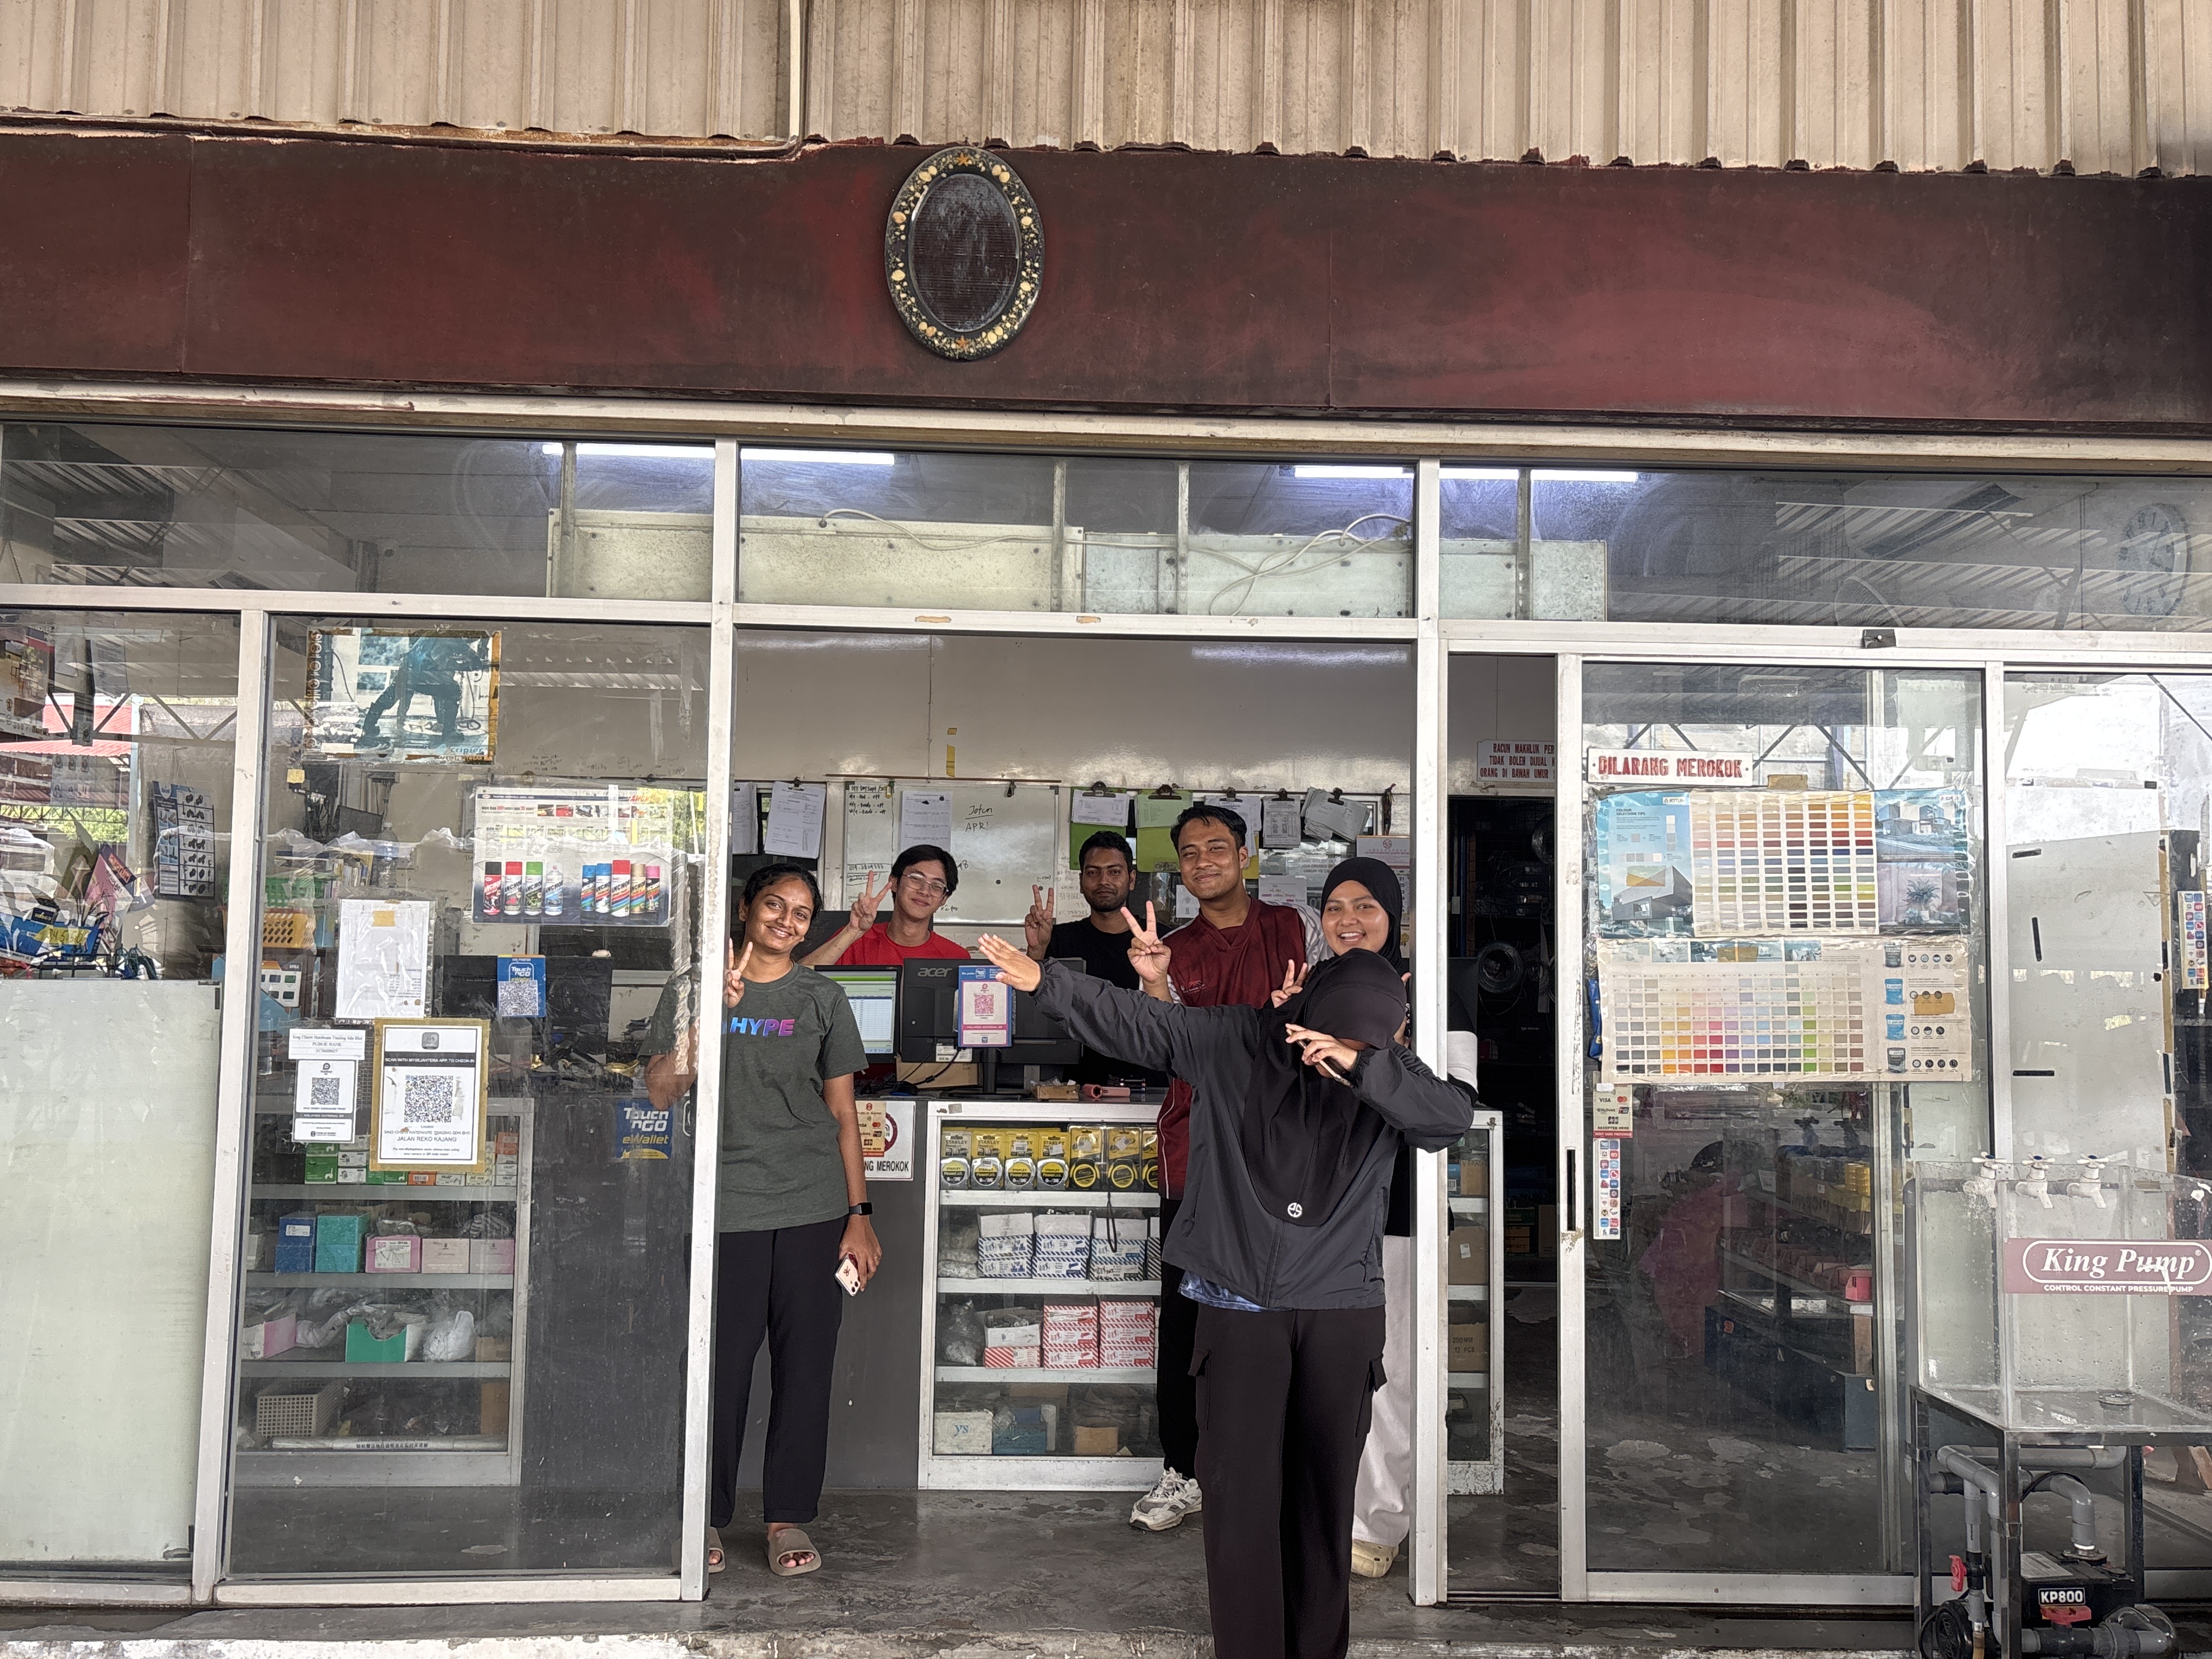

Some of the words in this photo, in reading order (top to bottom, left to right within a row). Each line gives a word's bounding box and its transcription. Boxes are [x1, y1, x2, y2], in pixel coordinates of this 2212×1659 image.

[1493, 743, 1510, 753] RACUN
[1515, 744, 1539, 754] MAKHLUK
[1489, 755, 1504, 765] TIDAK
[1509, 756, 1526, 765] BOLEH
[1530, 757, 1547, 766] DIJUAL
[1598, 755, 1668, 776] DILARANG
[1677, 758, 1742, 778] MEROKOK
[1480, 768, 1498, 777] ORANG
[1502, 769, 1508, 777] DI
[1512, 769, 1530, 778] BAWAH
[1534, 769, 1549, 778] UMUR
[917, 968, 953, 978] acer
[730, 1017, 795, 1036] HYPE
[622, 1135, 669, 1144] eWallet
[877, 1160, 909, 1171] MEROKOK
[2041, 1248, 2108, 1279] King
[2115, 1249, 2194, 1279] Pump
[953, 1425, 969, 1437] ys
[2040, 1590, 2083, 1603] KP800
